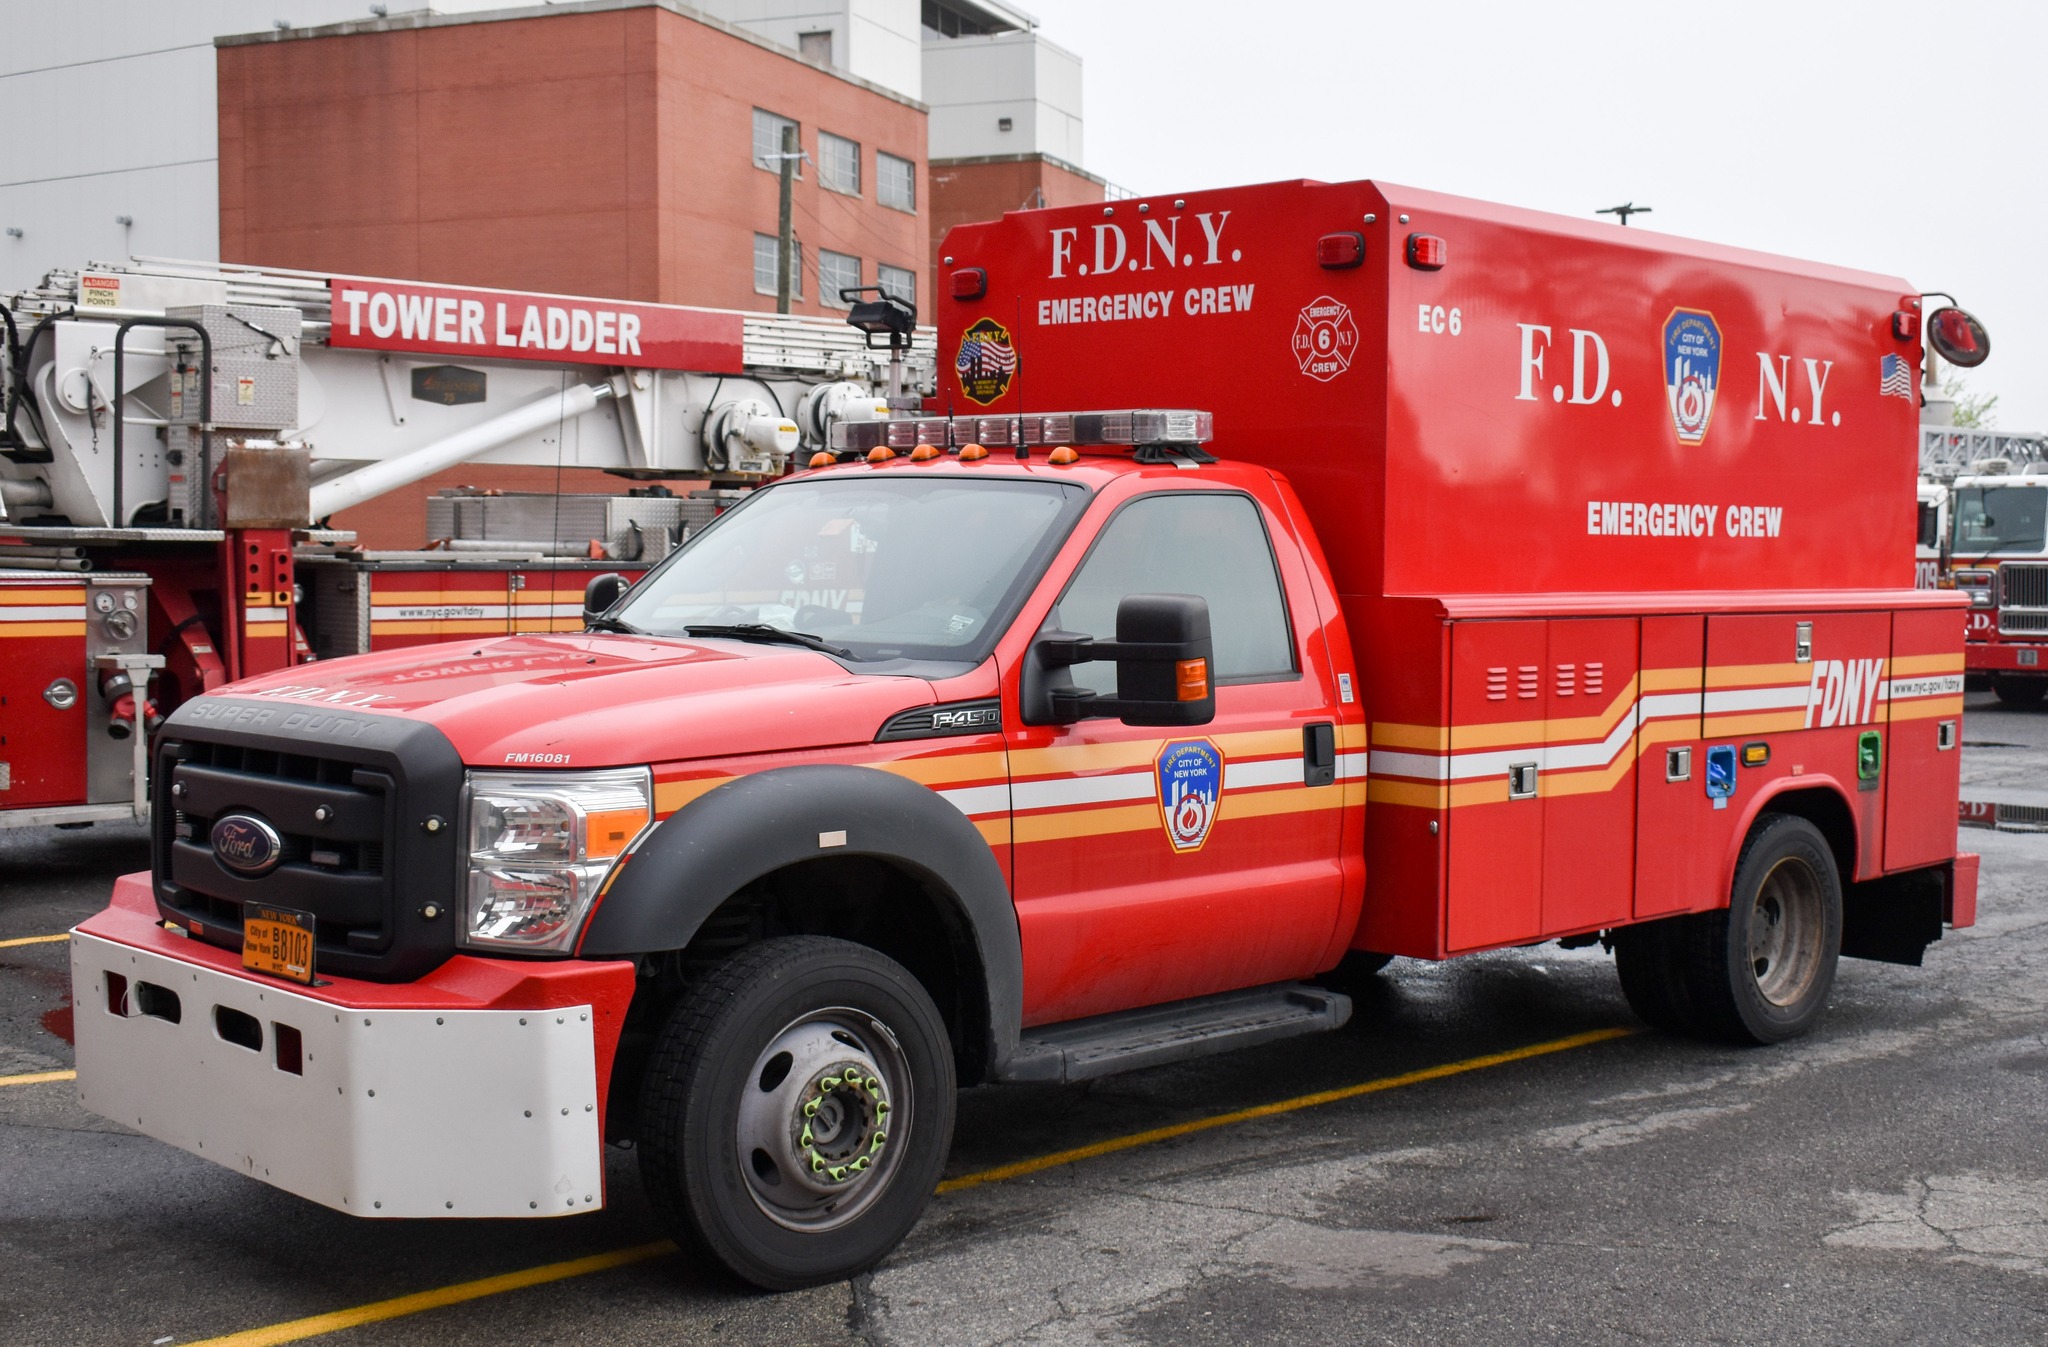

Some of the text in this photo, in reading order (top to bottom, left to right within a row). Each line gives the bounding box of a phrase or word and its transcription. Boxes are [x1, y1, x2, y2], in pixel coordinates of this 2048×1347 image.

[1048, 210, 1242, 279] F.D.N.Y.
[91, 278, 119, 288] DANGER
[89, 289, 114, 297] PINCH
[87, 298, 116, 306] POINTS
[1038, 283, 1255, 325] EMERGENCY CREW
[1309, 305, 1340, 317] EMERGENCY
[342, 289, 642, 356] TOWER LADDER
[1318, 329, 1330, 350] 6
[1682, 333, 1704, 344] CITY OF
[1678, 345, 1708, 357] NEW YORK
[1312, 362, 1338, 373] CREW
[1514, 322, 1622, 407] F.D.
[1754, 351, 1841, 427] N.Y.
[1587, 501, 1783, 538] EMERGENCY CREW
[399, 605, 484, 619] www.nyc.gov/fdny
[1804, 658, 1884, 729] FDNY
[1893, 677, 1960, 695] www.nyc.gov/fdny
[190, 703, 381, 738] SUPER DUTY
[932, 708, 1000, 730] F-450
[504, 752, 571, 764] FM16081
[1164, 746, 1216, 773] FIRE DEPARTMENT
[1178, 758, 1203, 768] CITY OF
[1174, 768, 1208, 778] NEW YORK
[219, 823, 257, 859] Ford
[261, 909, 298, 925] NEW YORK
[250, 925, 269, 939] City of
[245, 940, 271, 954] New York
